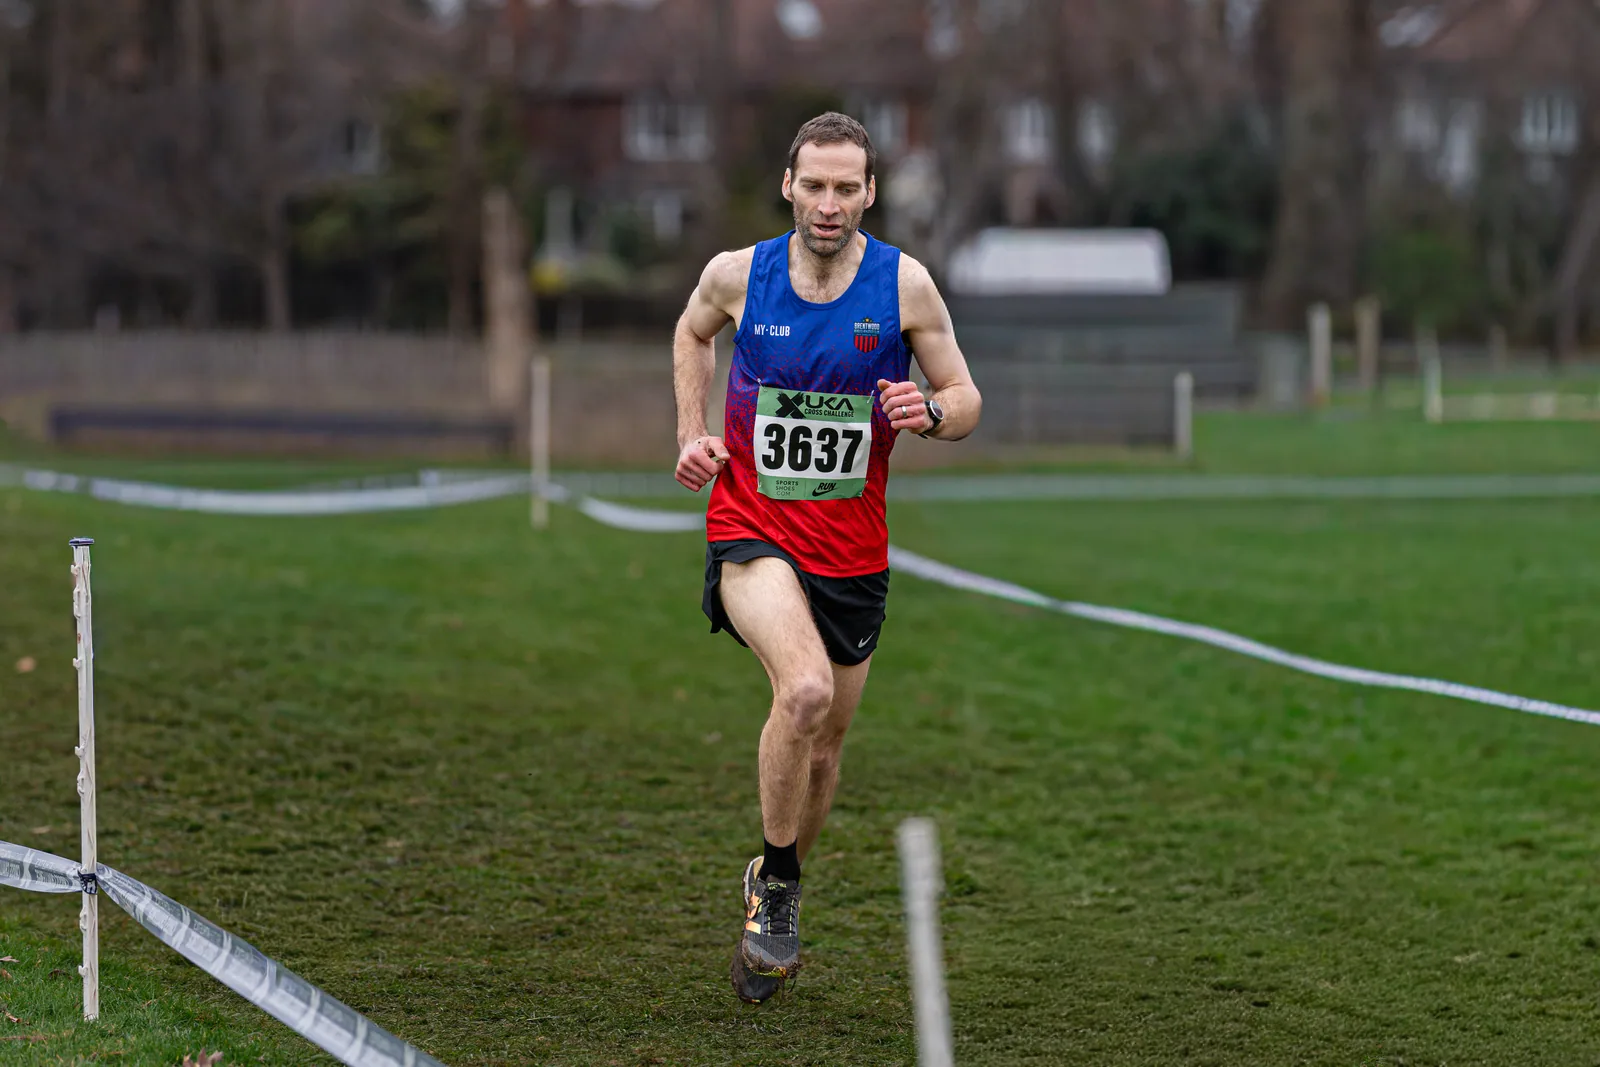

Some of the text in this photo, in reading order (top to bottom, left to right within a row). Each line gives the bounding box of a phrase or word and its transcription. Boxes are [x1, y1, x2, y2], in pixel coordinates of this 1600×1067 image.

[805, 395, 854, 411] UKA
[804, 408, 855, 418] CROSS CHALLENGE
[762, 423, 863, 474] 3637
[817, 482, 837, 491] RUN
